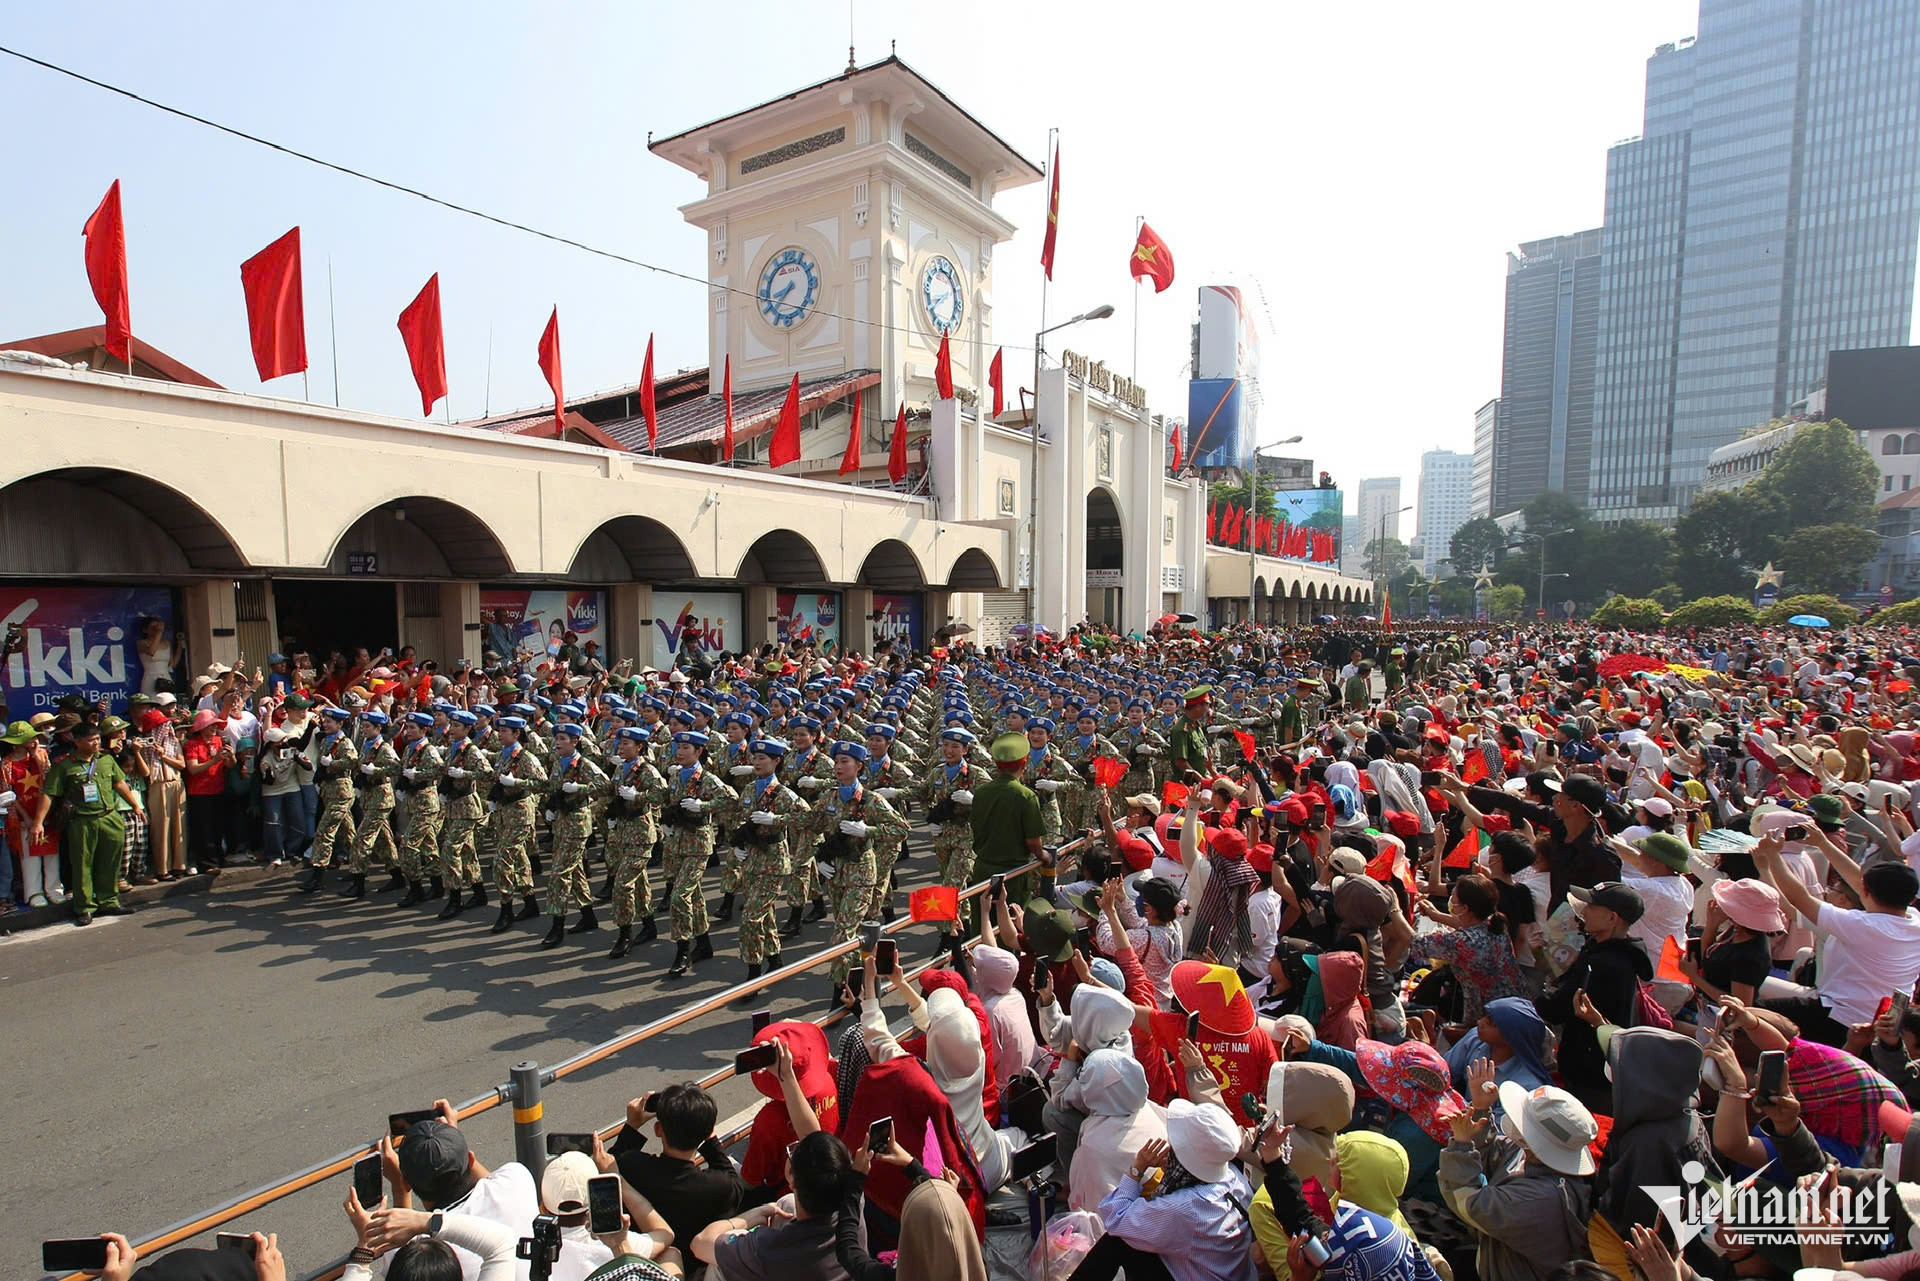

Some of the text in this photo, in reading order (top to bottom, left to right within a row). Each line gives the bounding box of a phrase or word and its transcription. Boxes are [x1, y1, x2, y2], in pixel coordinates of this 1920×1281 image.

[367, 556, 376, 572] 2
[568, 598, 596, 619] Vikki
[656, 601, 724, 654] Vki
[89, 688, 128, 705] Bank
[1213, 1040, 1230, 1053] VIỆT
[1231, 1042, 1250, 1053] NAM
